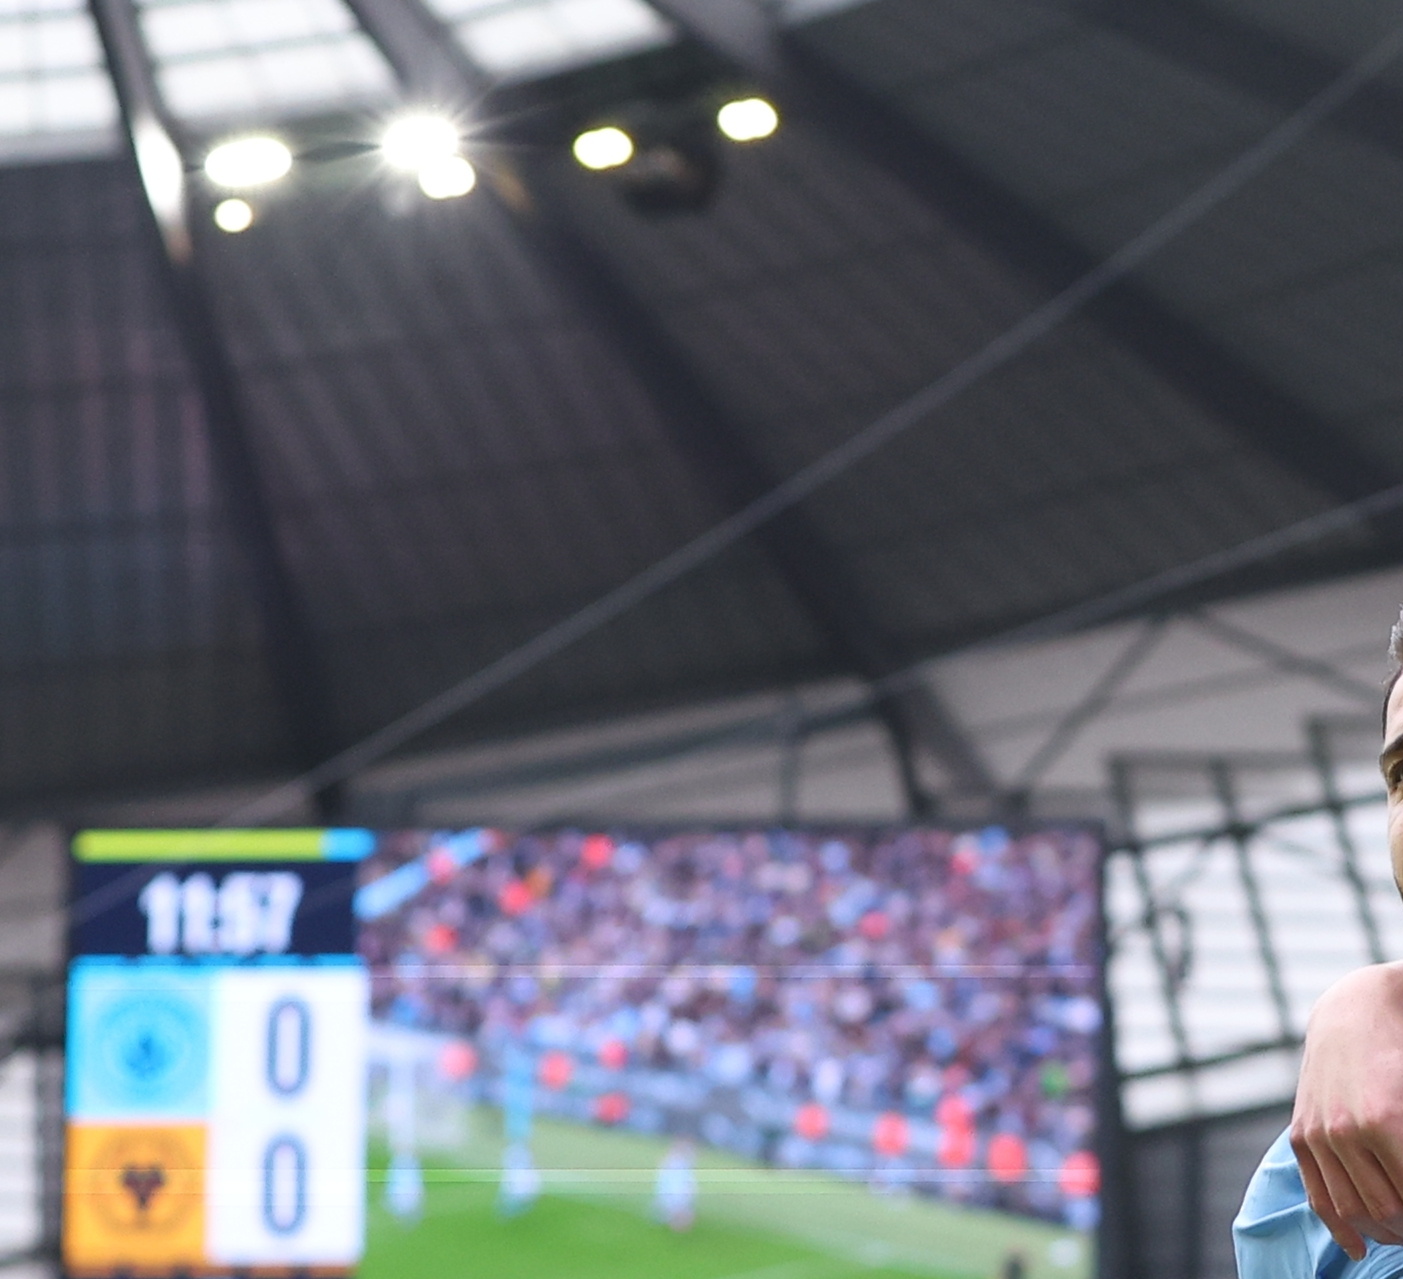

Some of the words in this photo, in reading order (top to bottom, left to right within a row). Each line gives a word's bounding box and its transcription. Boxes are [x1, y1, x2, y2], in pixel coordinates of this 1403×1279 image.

[138, 870, 303, 956] 11:57
[264, 991, 311, 1102] 0
[261, 1130, 307, 1239] 0
